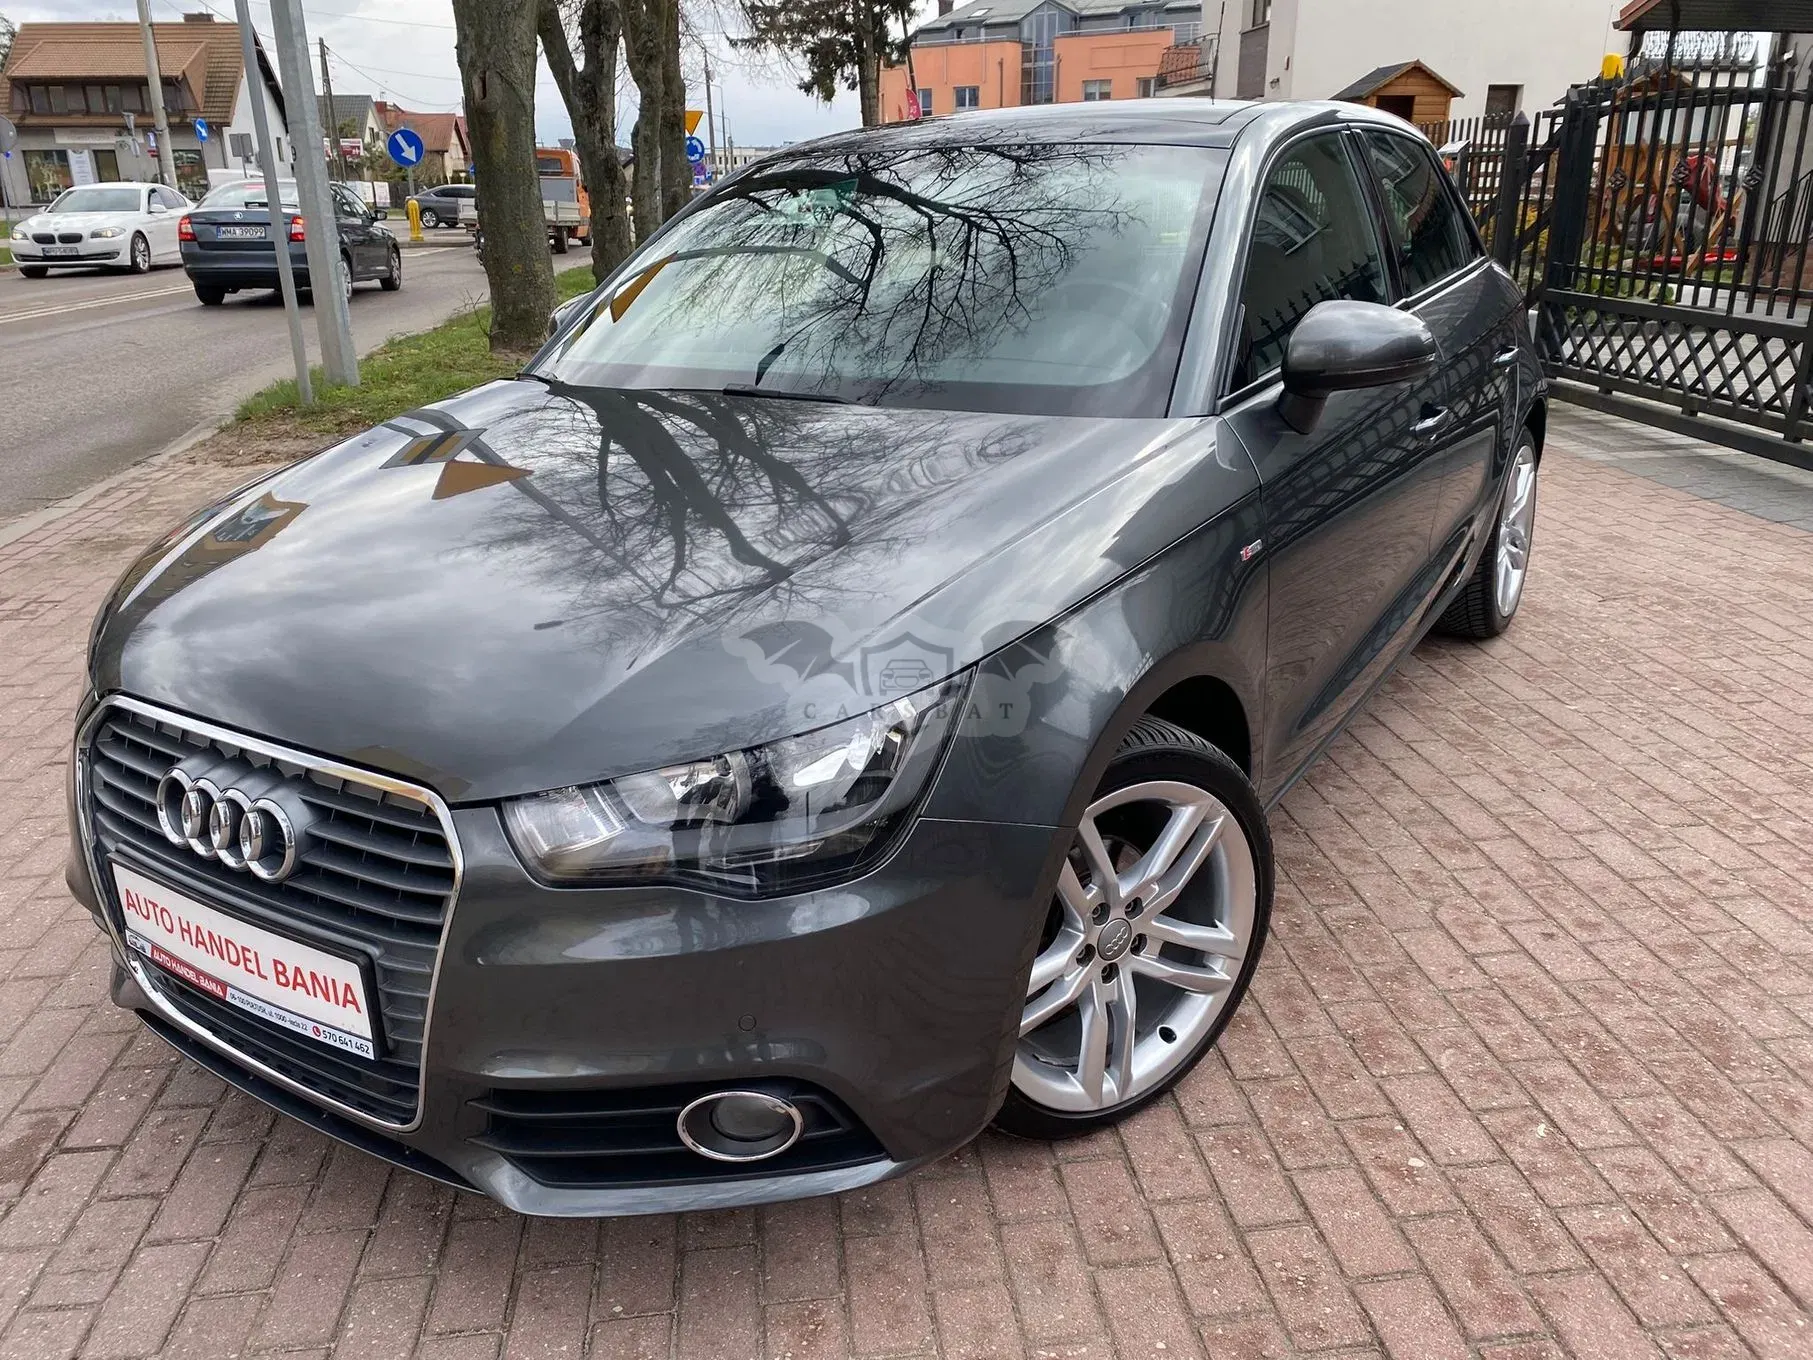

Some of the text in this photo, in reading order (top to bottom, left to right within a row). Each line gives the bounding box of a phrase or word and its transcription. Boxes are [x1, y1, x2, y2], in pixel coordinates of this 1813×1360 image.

[220, 227, 264, 236] WMA 39099
[125, 888, 362, 1014] AUTO HANDEL BANIA
[153, 949, 224, 996] AUTO HANDEL BANIA
[322, 1030, 370, 1054] 570 641 462
